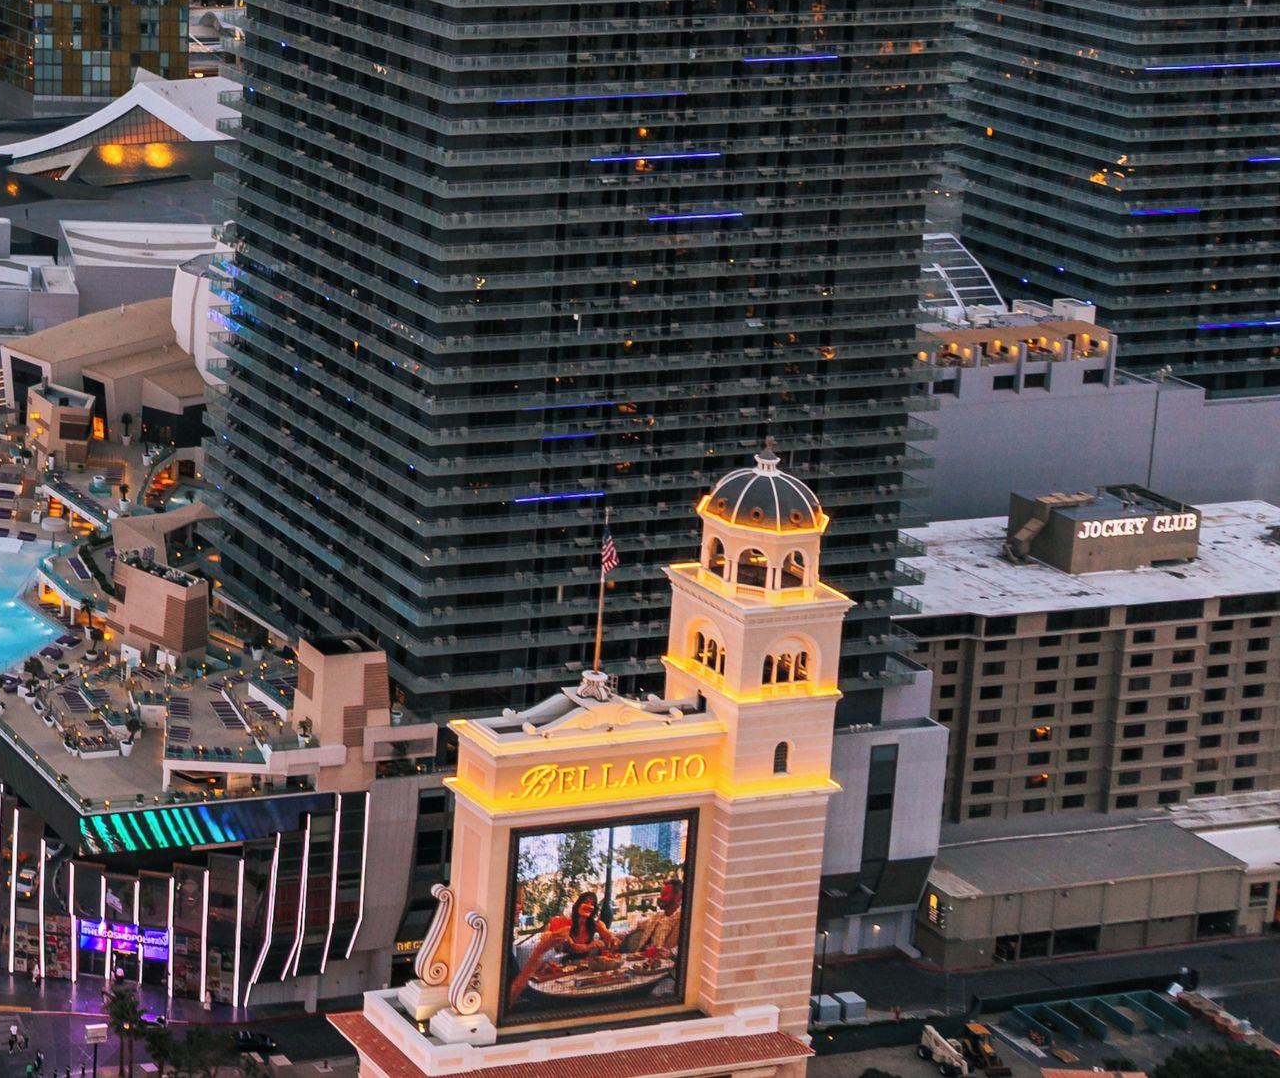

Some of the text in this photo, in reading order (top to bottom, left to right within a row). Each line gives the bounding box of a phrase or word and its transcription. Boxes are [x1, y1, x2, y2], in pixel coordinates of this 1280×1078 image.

[1077, 512, 1197, 539] JOCKEY CLUB
[507, 753, 706, 801] BELLAGIO
[103, 930, 169, 946] COSMOPOLITAN
